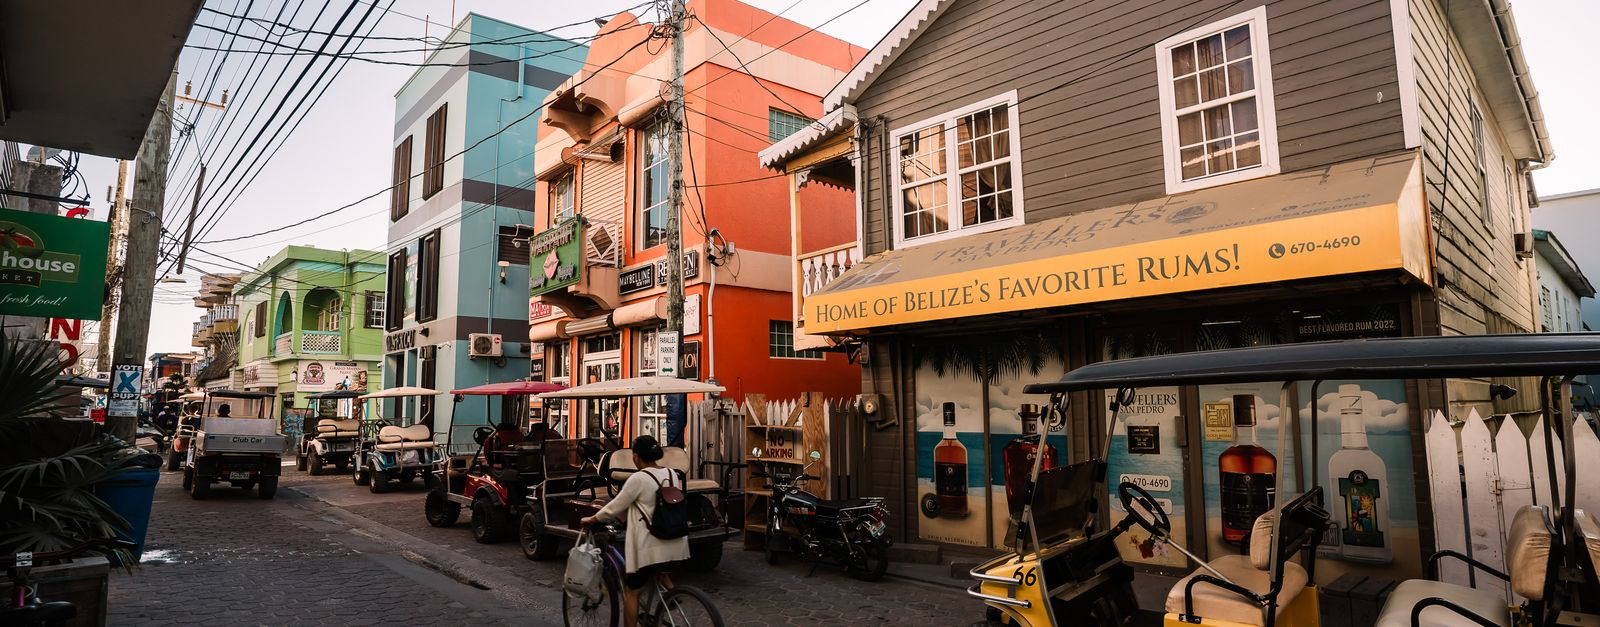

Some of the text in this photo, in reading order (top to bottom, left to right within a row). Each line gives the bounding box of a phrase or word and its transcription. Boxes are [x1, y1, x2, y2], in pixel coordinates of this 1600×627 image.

[1290, 235, 1361, 255] 670-4690
[2, 250, 76, 273] house
[658, 252, 694, 278] REEN
[619, 268, 651, 286] MAYBELLINE
[816, 243, 1241, 323] HOME OF BELIZE'S FAVORITE RUMS!
[27, 295, 67, 307] food!
[1299, 320, 1394, 334] BEST FLAVORED RUM 2022
[659, 336, 676, 344] PARALLEL
[660, 346, 675, 354] PARKING
[663, 356, 672, 364] ONLY
[112, 392, 141, 400] PUP7
[1108, 393, 1177, 406] TVELLERS
[1120, 405, 1165, 414] SAN PEDRO
[1029, 423, 1036, 431] 10
[770, 435, 784, 447] NO
[766, 448, 793, 459] ARKING
[1133, 477, 1169, 488] 670-4690
[1013, 566, 1037, 587] 66
